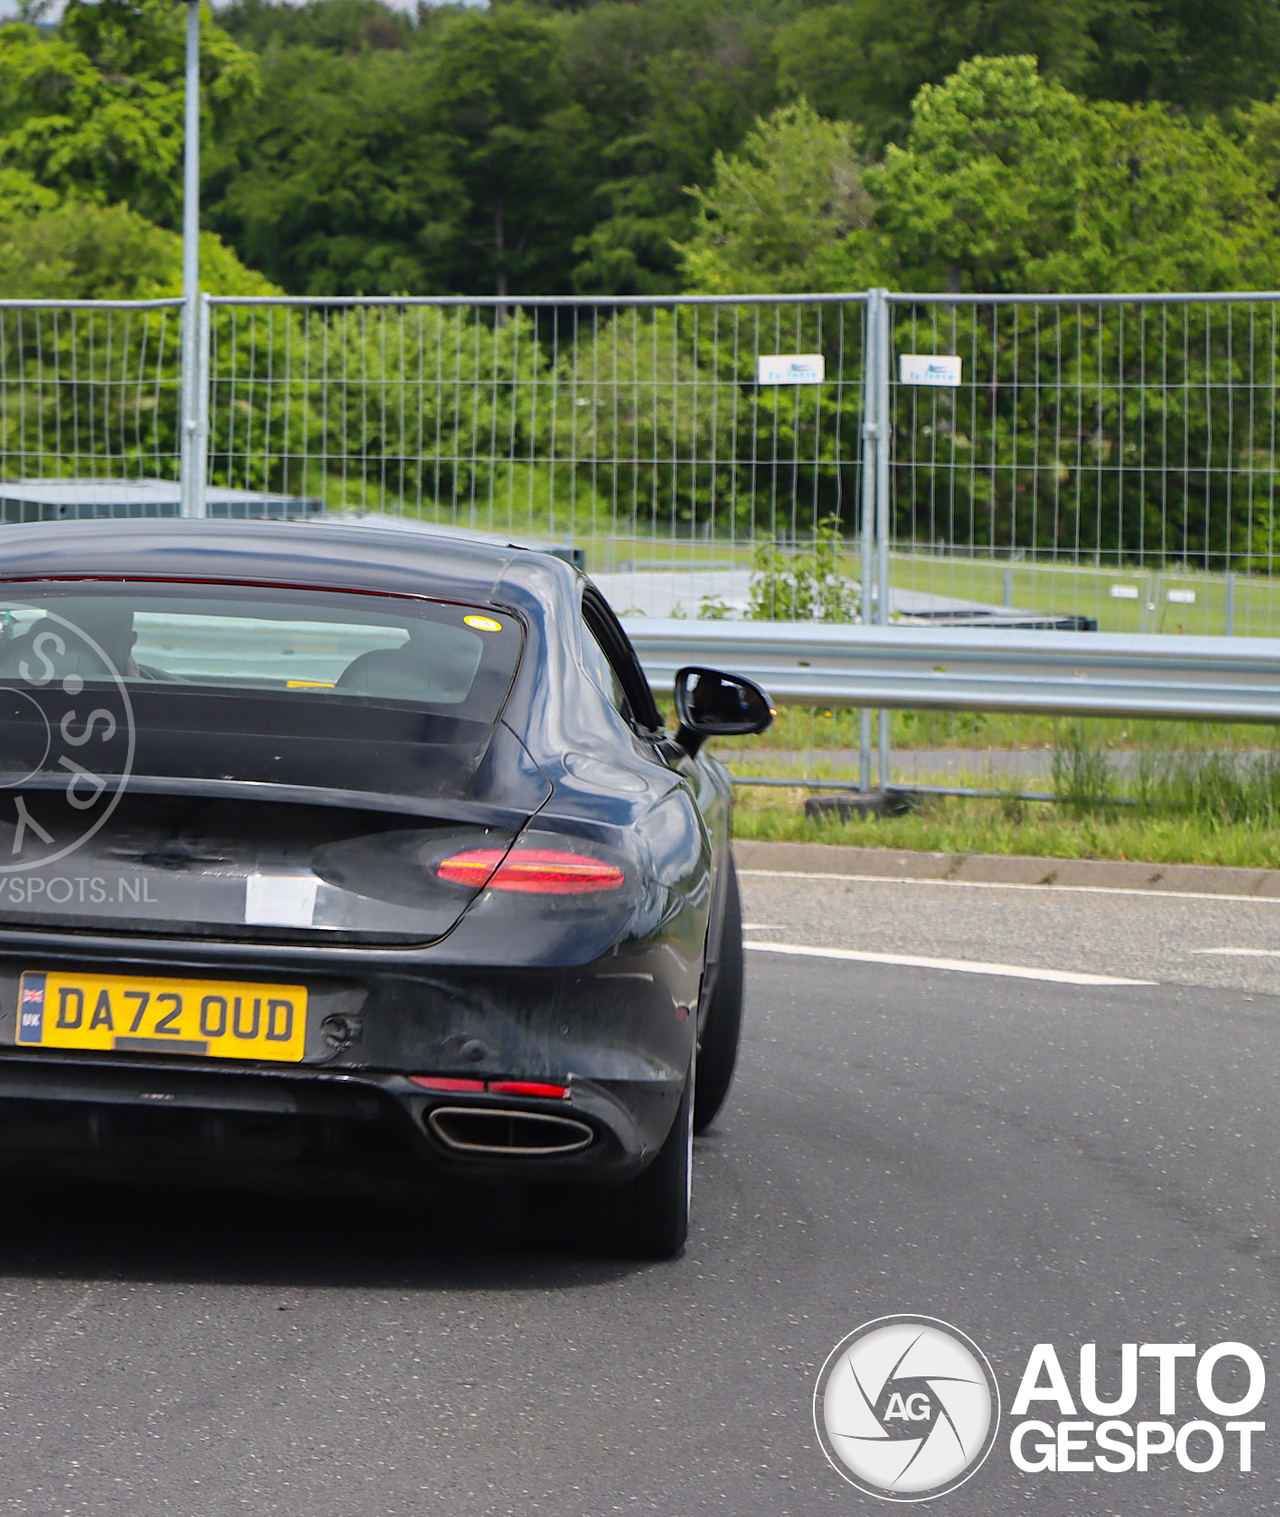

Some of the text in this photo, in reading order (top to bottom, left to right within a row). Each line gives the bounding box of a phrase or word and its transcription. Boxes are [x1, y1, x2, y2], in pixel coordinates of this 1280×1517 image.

[22, 1013, 40, 1026] UK
[55, 987, 294, 1042] DA72 OUD
